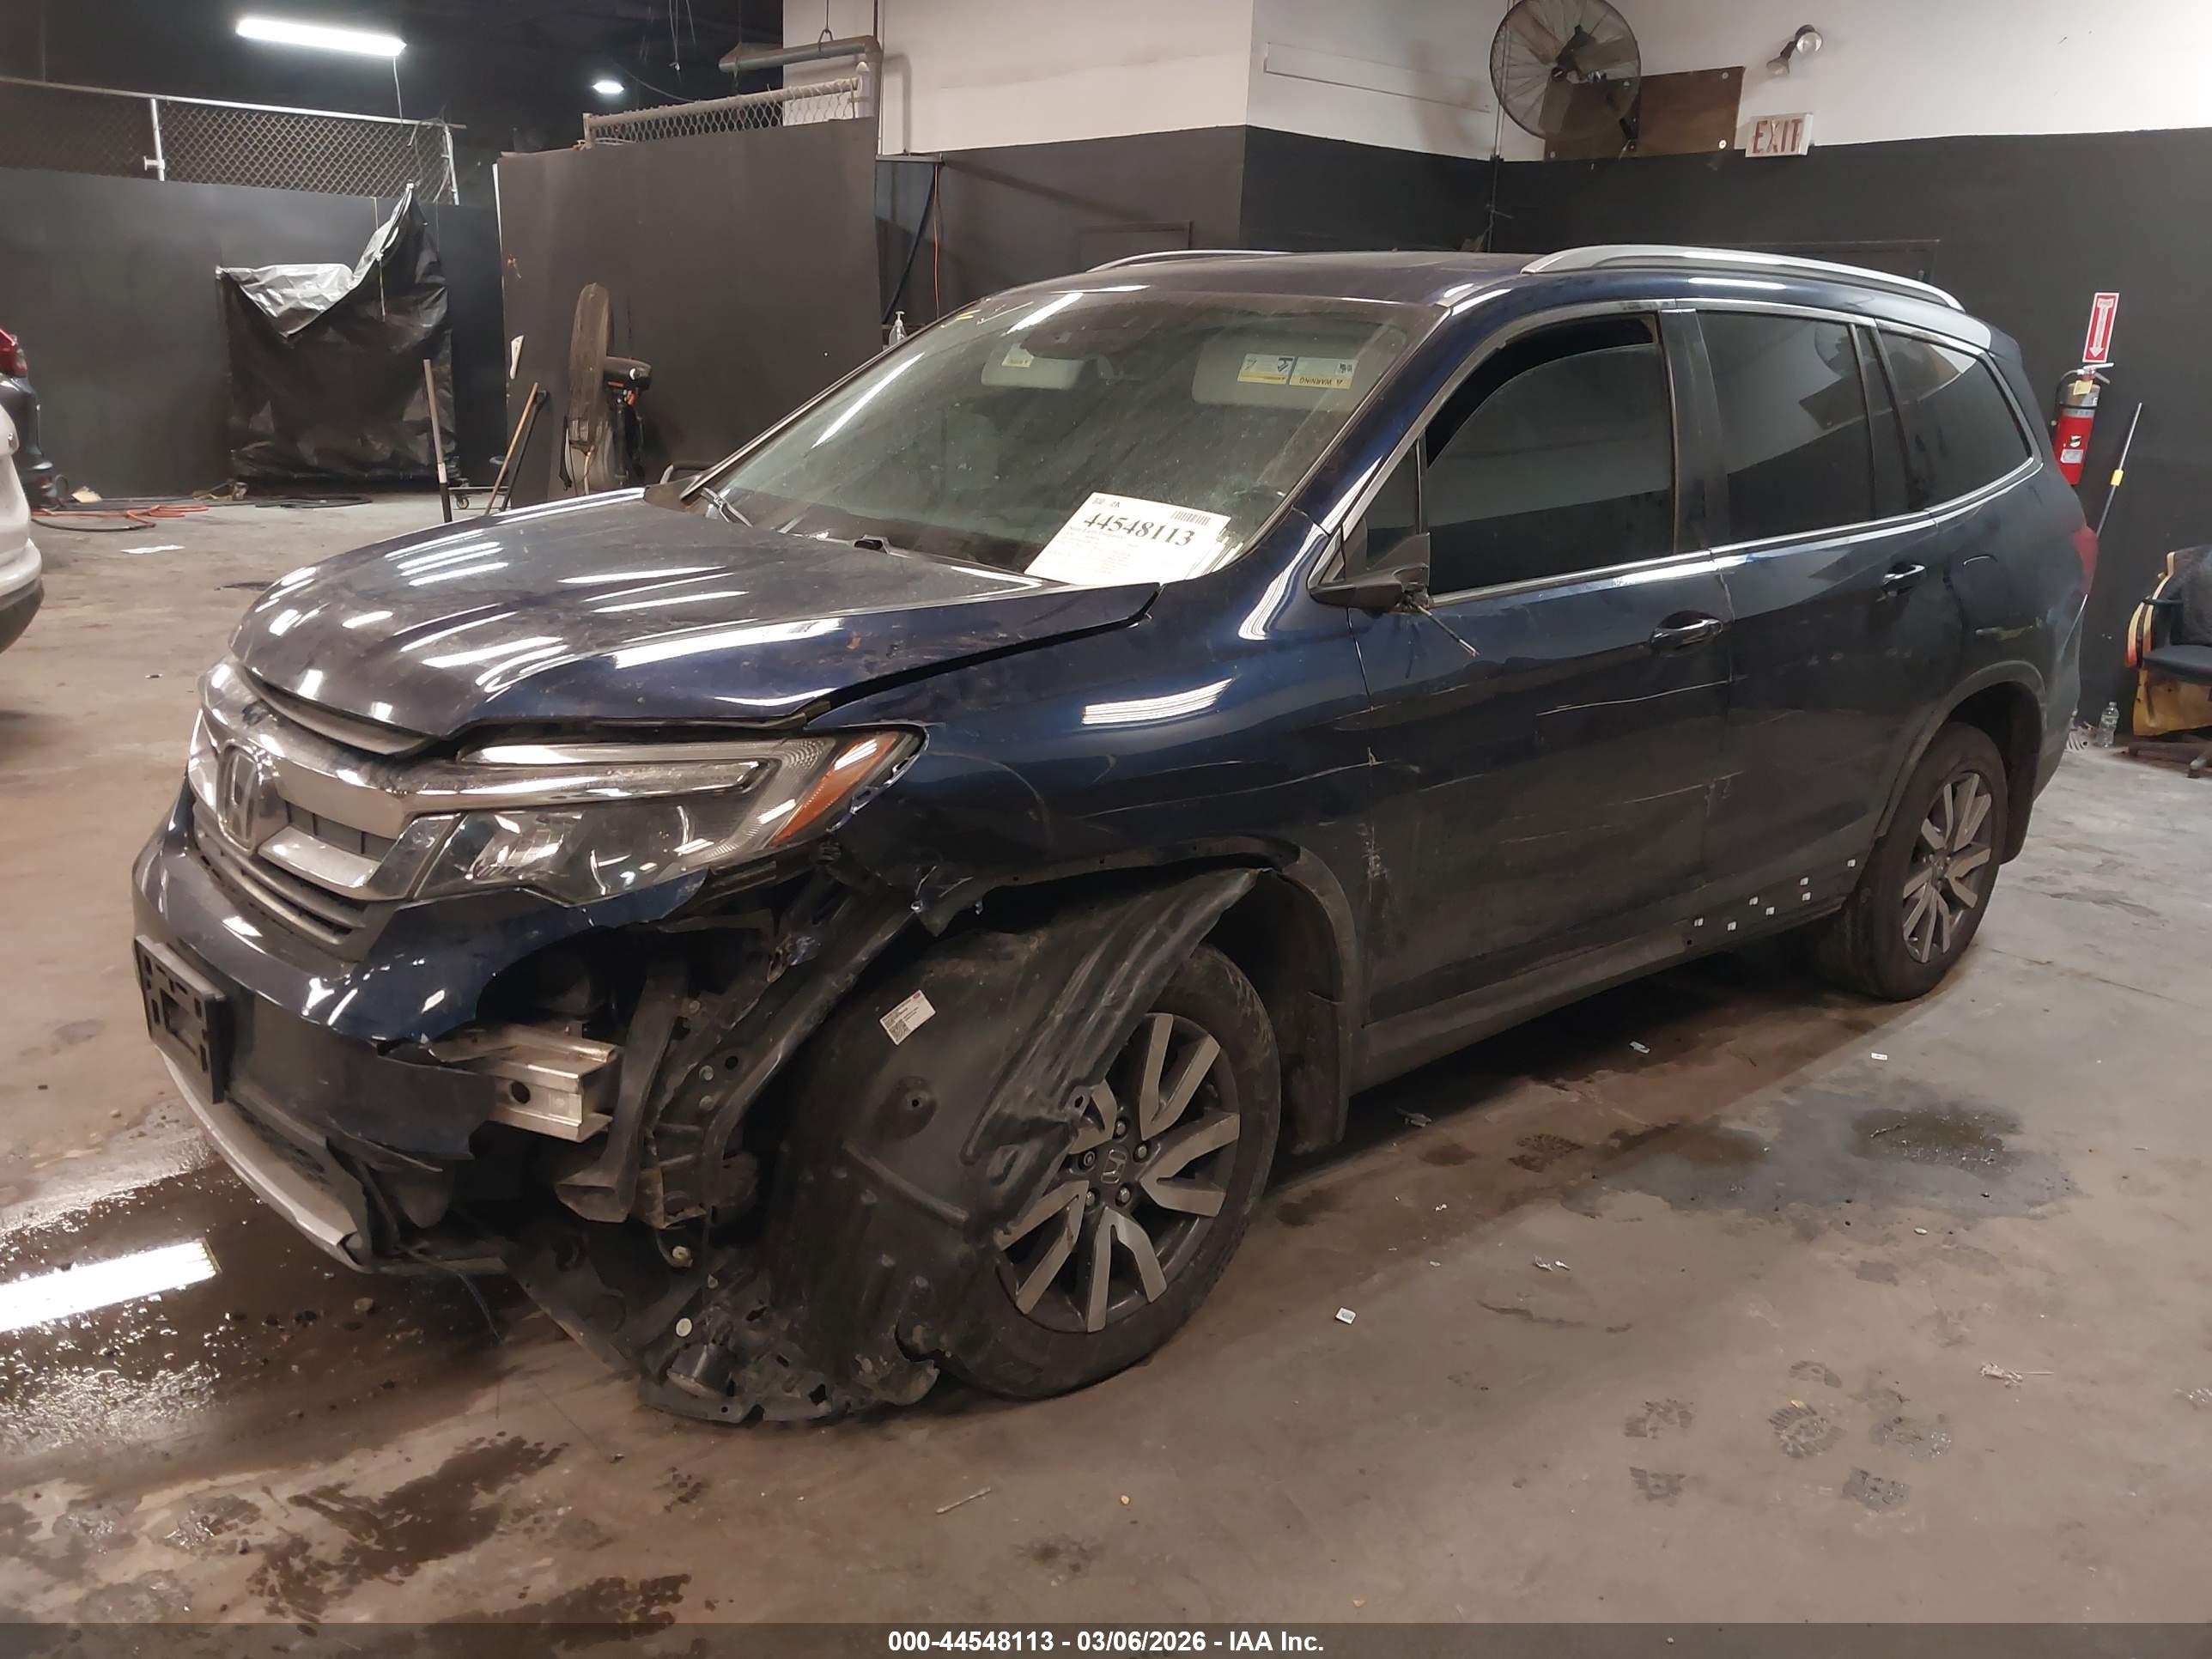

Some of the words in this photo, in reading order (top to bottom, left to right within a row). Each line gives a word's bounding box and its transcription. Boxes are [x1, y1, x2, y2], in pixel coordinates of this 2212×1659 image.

[1752, 118, 1802, 154] EXIT
[1298, 376, 1332, 386] WARNING
[1084, 513, 1195, 546] 44548113
